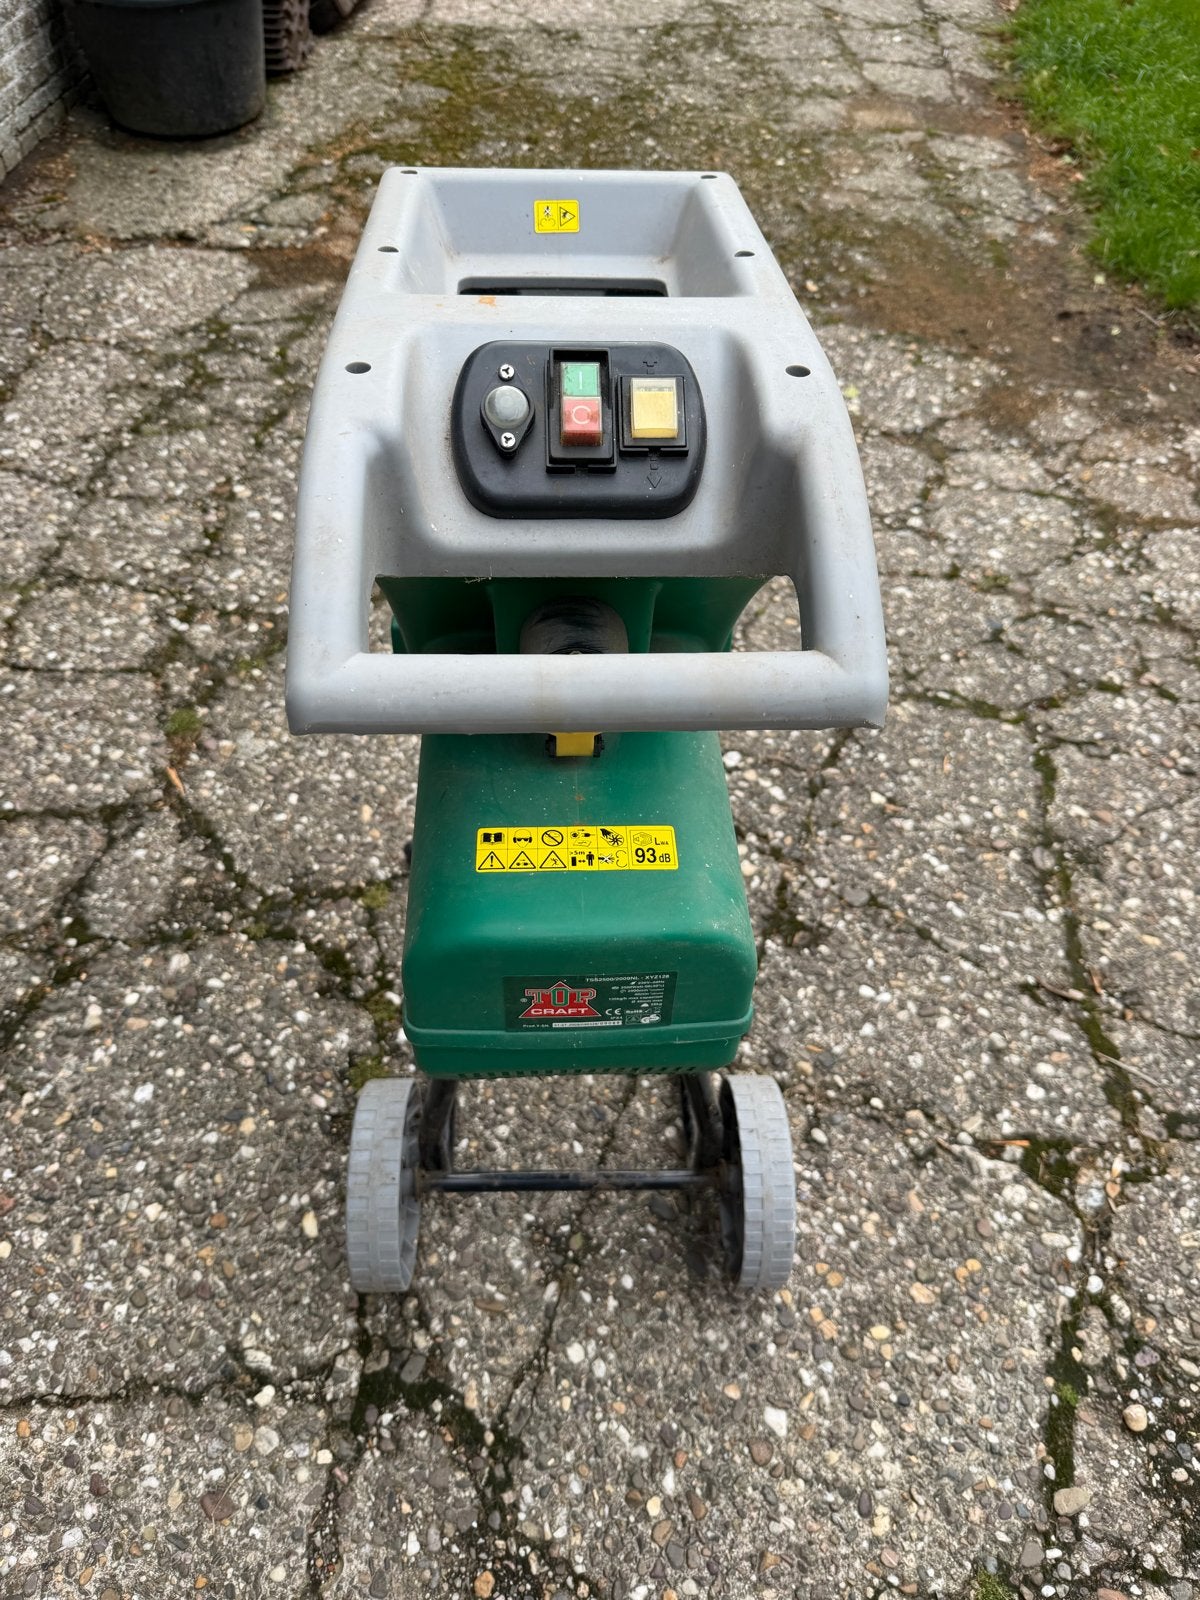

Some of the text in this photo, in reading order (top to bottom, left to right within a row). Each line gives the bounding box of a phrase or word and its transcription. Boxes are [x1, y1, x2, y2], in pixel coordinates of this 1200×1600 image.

[634, 847, 671, 864] 93 dB
[524, 987, 597, 1007] TOP
